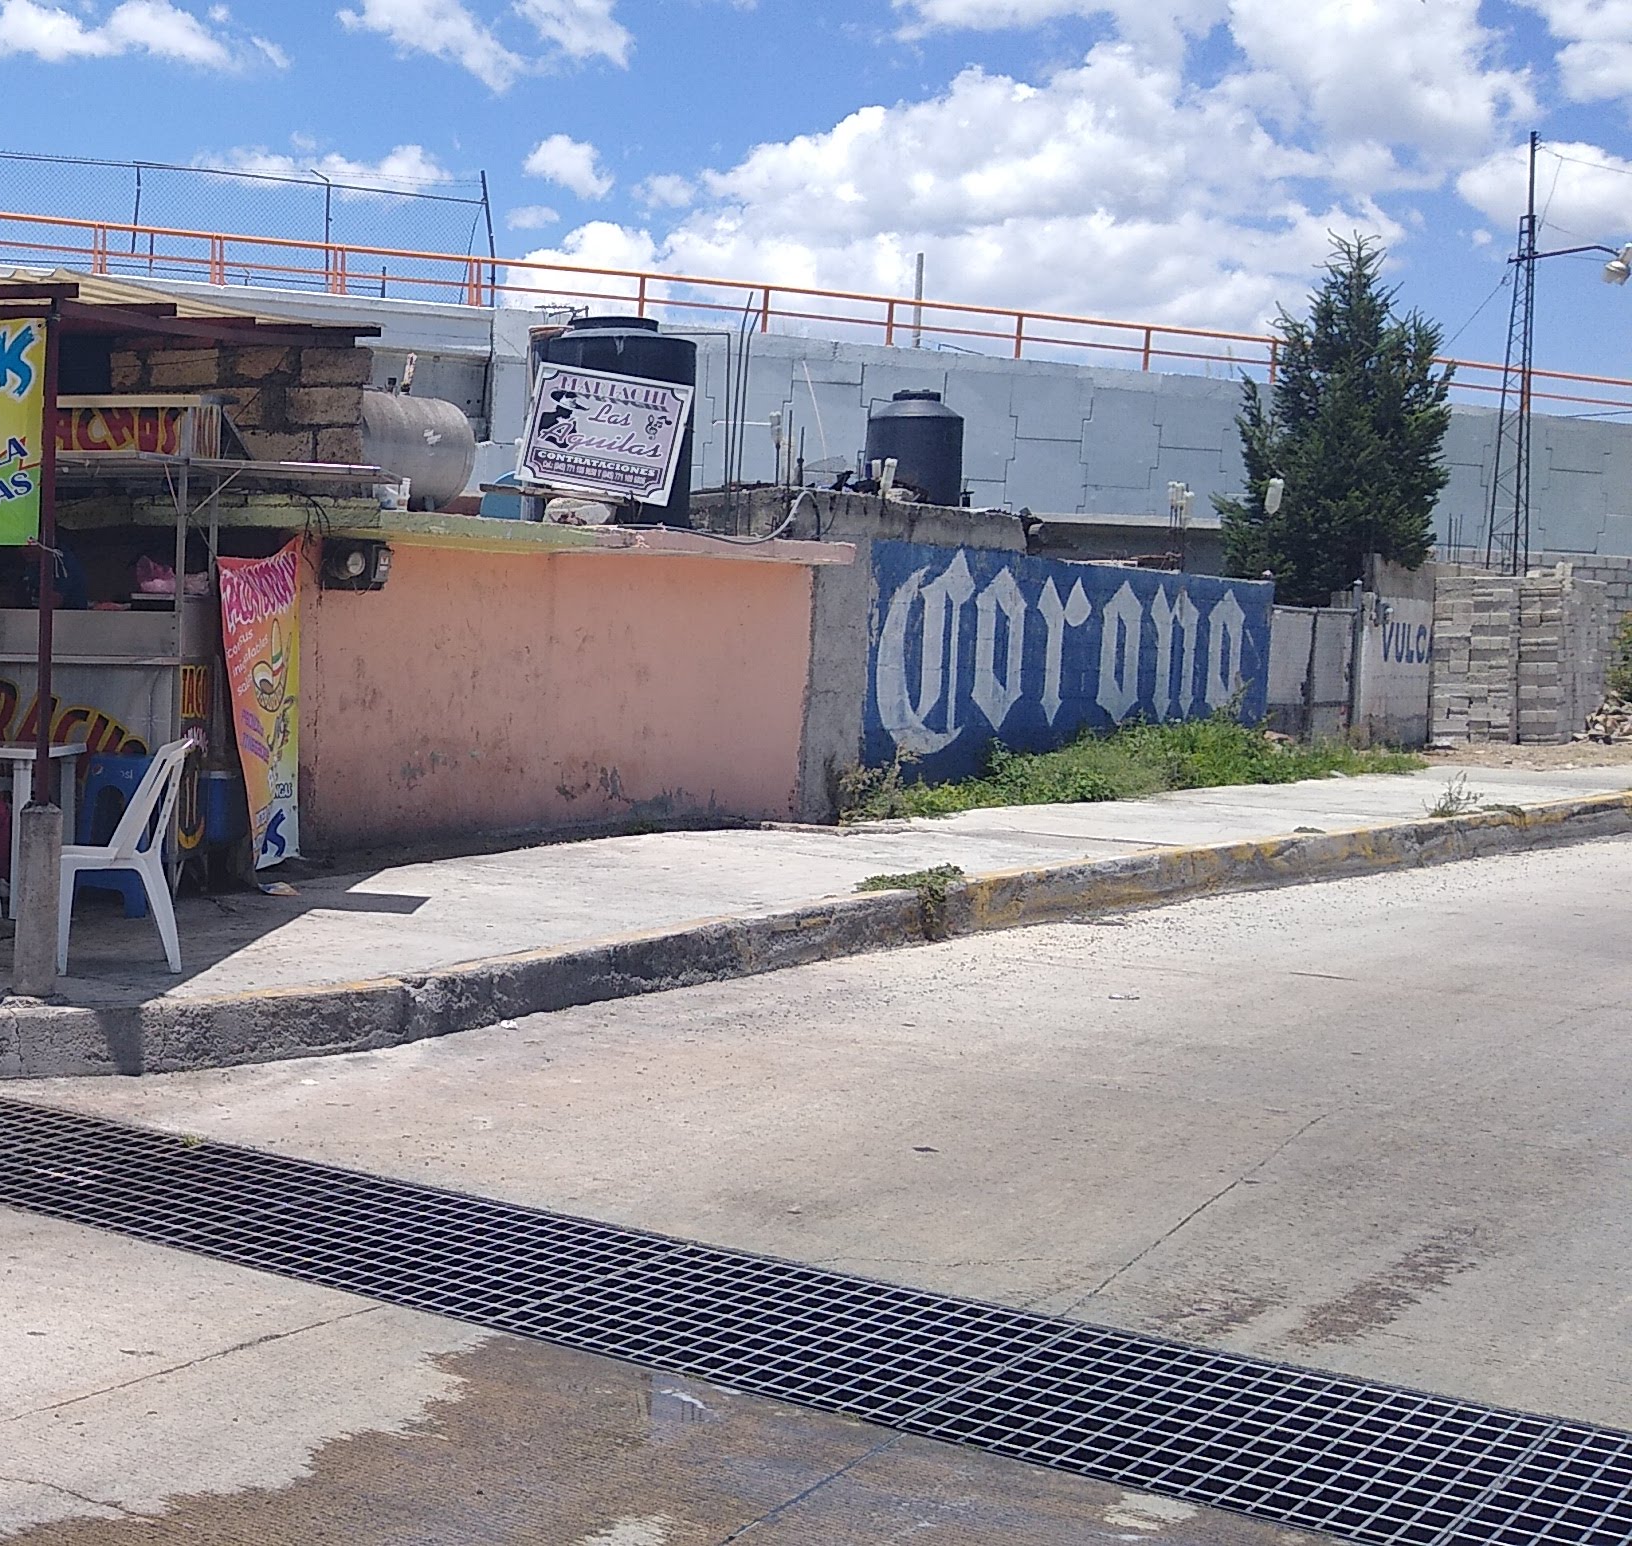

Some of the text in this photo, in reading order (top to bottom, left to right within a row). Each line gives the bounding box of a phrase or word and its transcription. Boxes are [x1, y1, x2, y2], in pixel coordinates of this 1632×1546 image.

[588, 404, 632, 427] Las
[537, 450, 656, 477] CONTRATACIONES
[876, 548, 1247, 754] Corona
